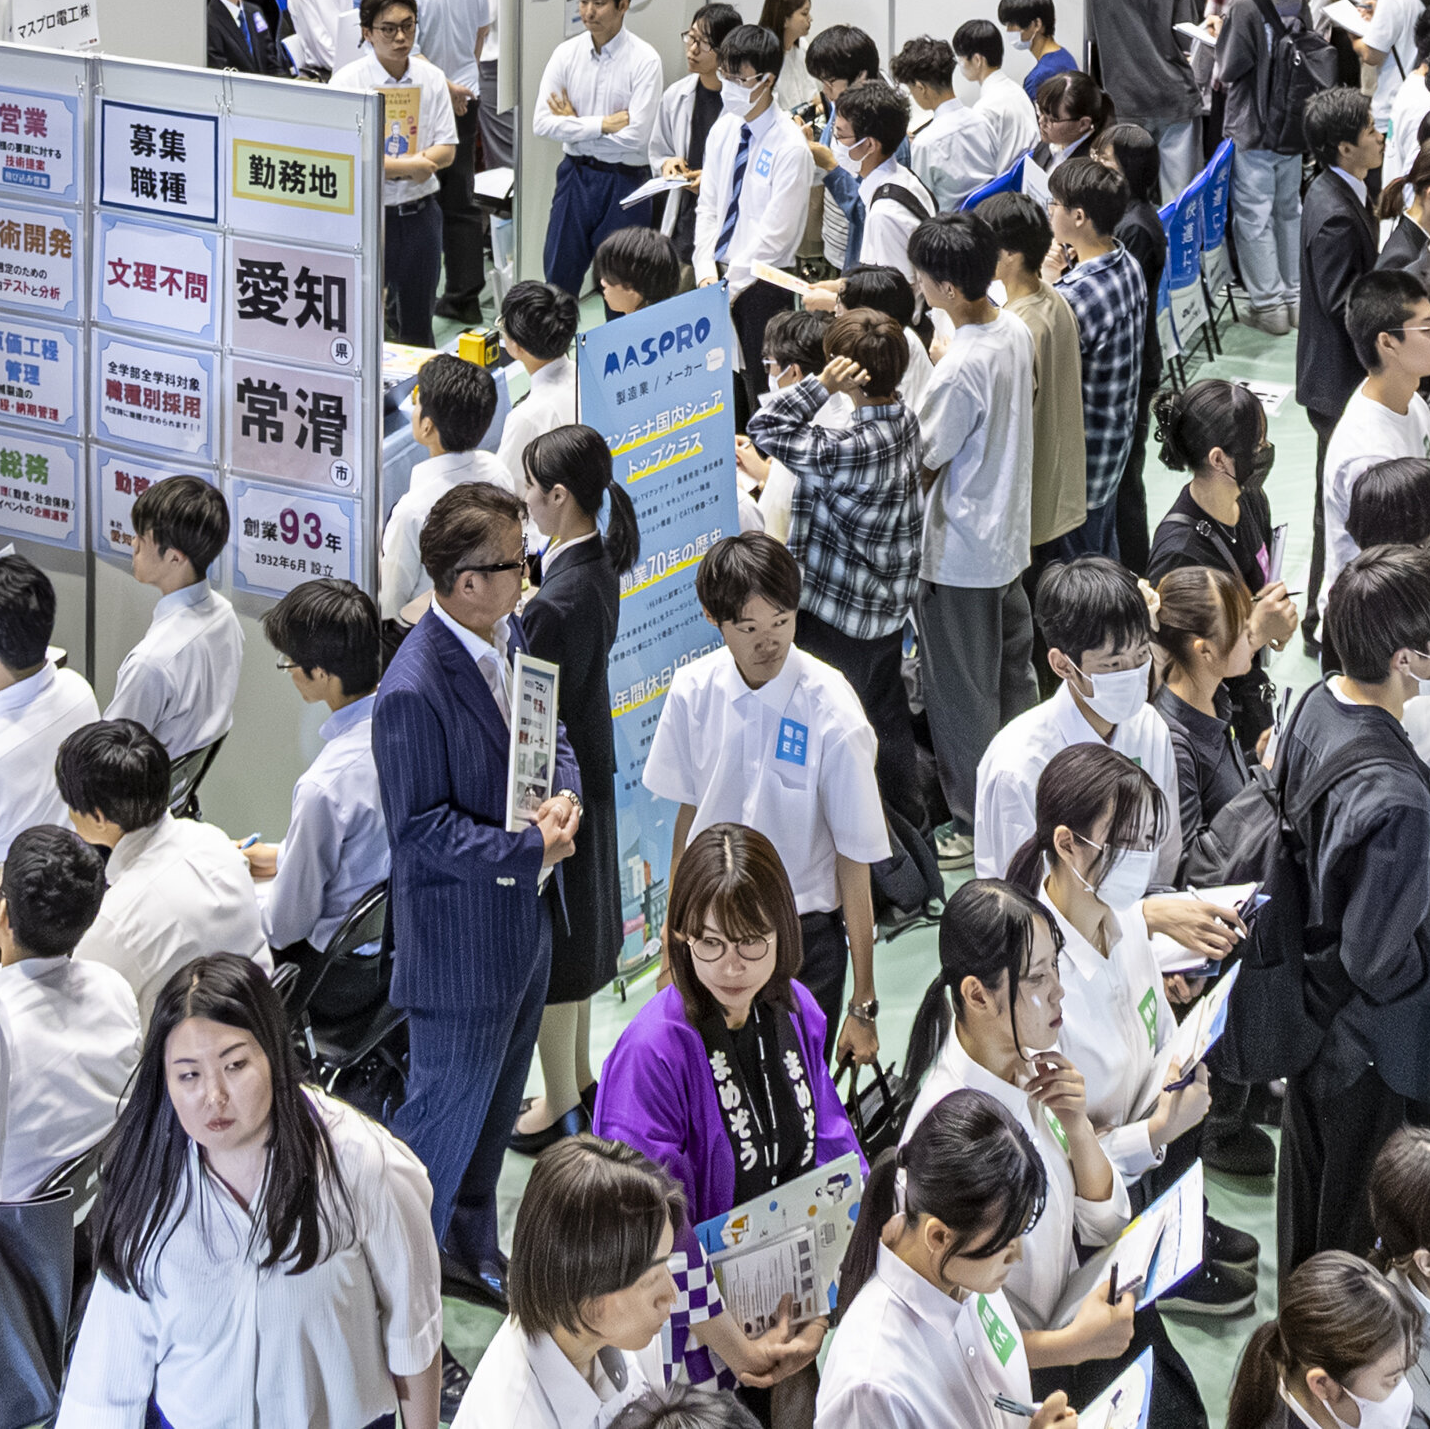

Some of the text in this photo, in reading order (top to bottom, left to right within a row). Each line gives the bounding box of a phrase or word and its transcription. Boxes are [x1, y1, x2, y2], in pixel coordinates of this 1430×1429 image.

[0, 104, 48, 138] 営業
[130, 124, 187, 163] 募集
[130, 168, 187, 205] 職種
[248, 156, 338, 199] 勤務地
[107, 259, 209, 304] 文理不問
[237, 259, 347, 334] 愛知
[334, 343, 348, 359] 県
[4, 359, 41, 387] 管理
[107, 362, 200, 393] 全学部全学科対象
[665, 363, 703, 385] メーカー
[105, 379, 201, 420] 職種別採用
[237, 378, 347, 458] 常滑
[0, 447, 49, 487] 総務
[334, 466, 348, 482] 市
[627, 432, 703, 479] トップクラス
[243, 508, 342, 555] 創業93年
[708, 1049, 760, 1172] まめぞう
